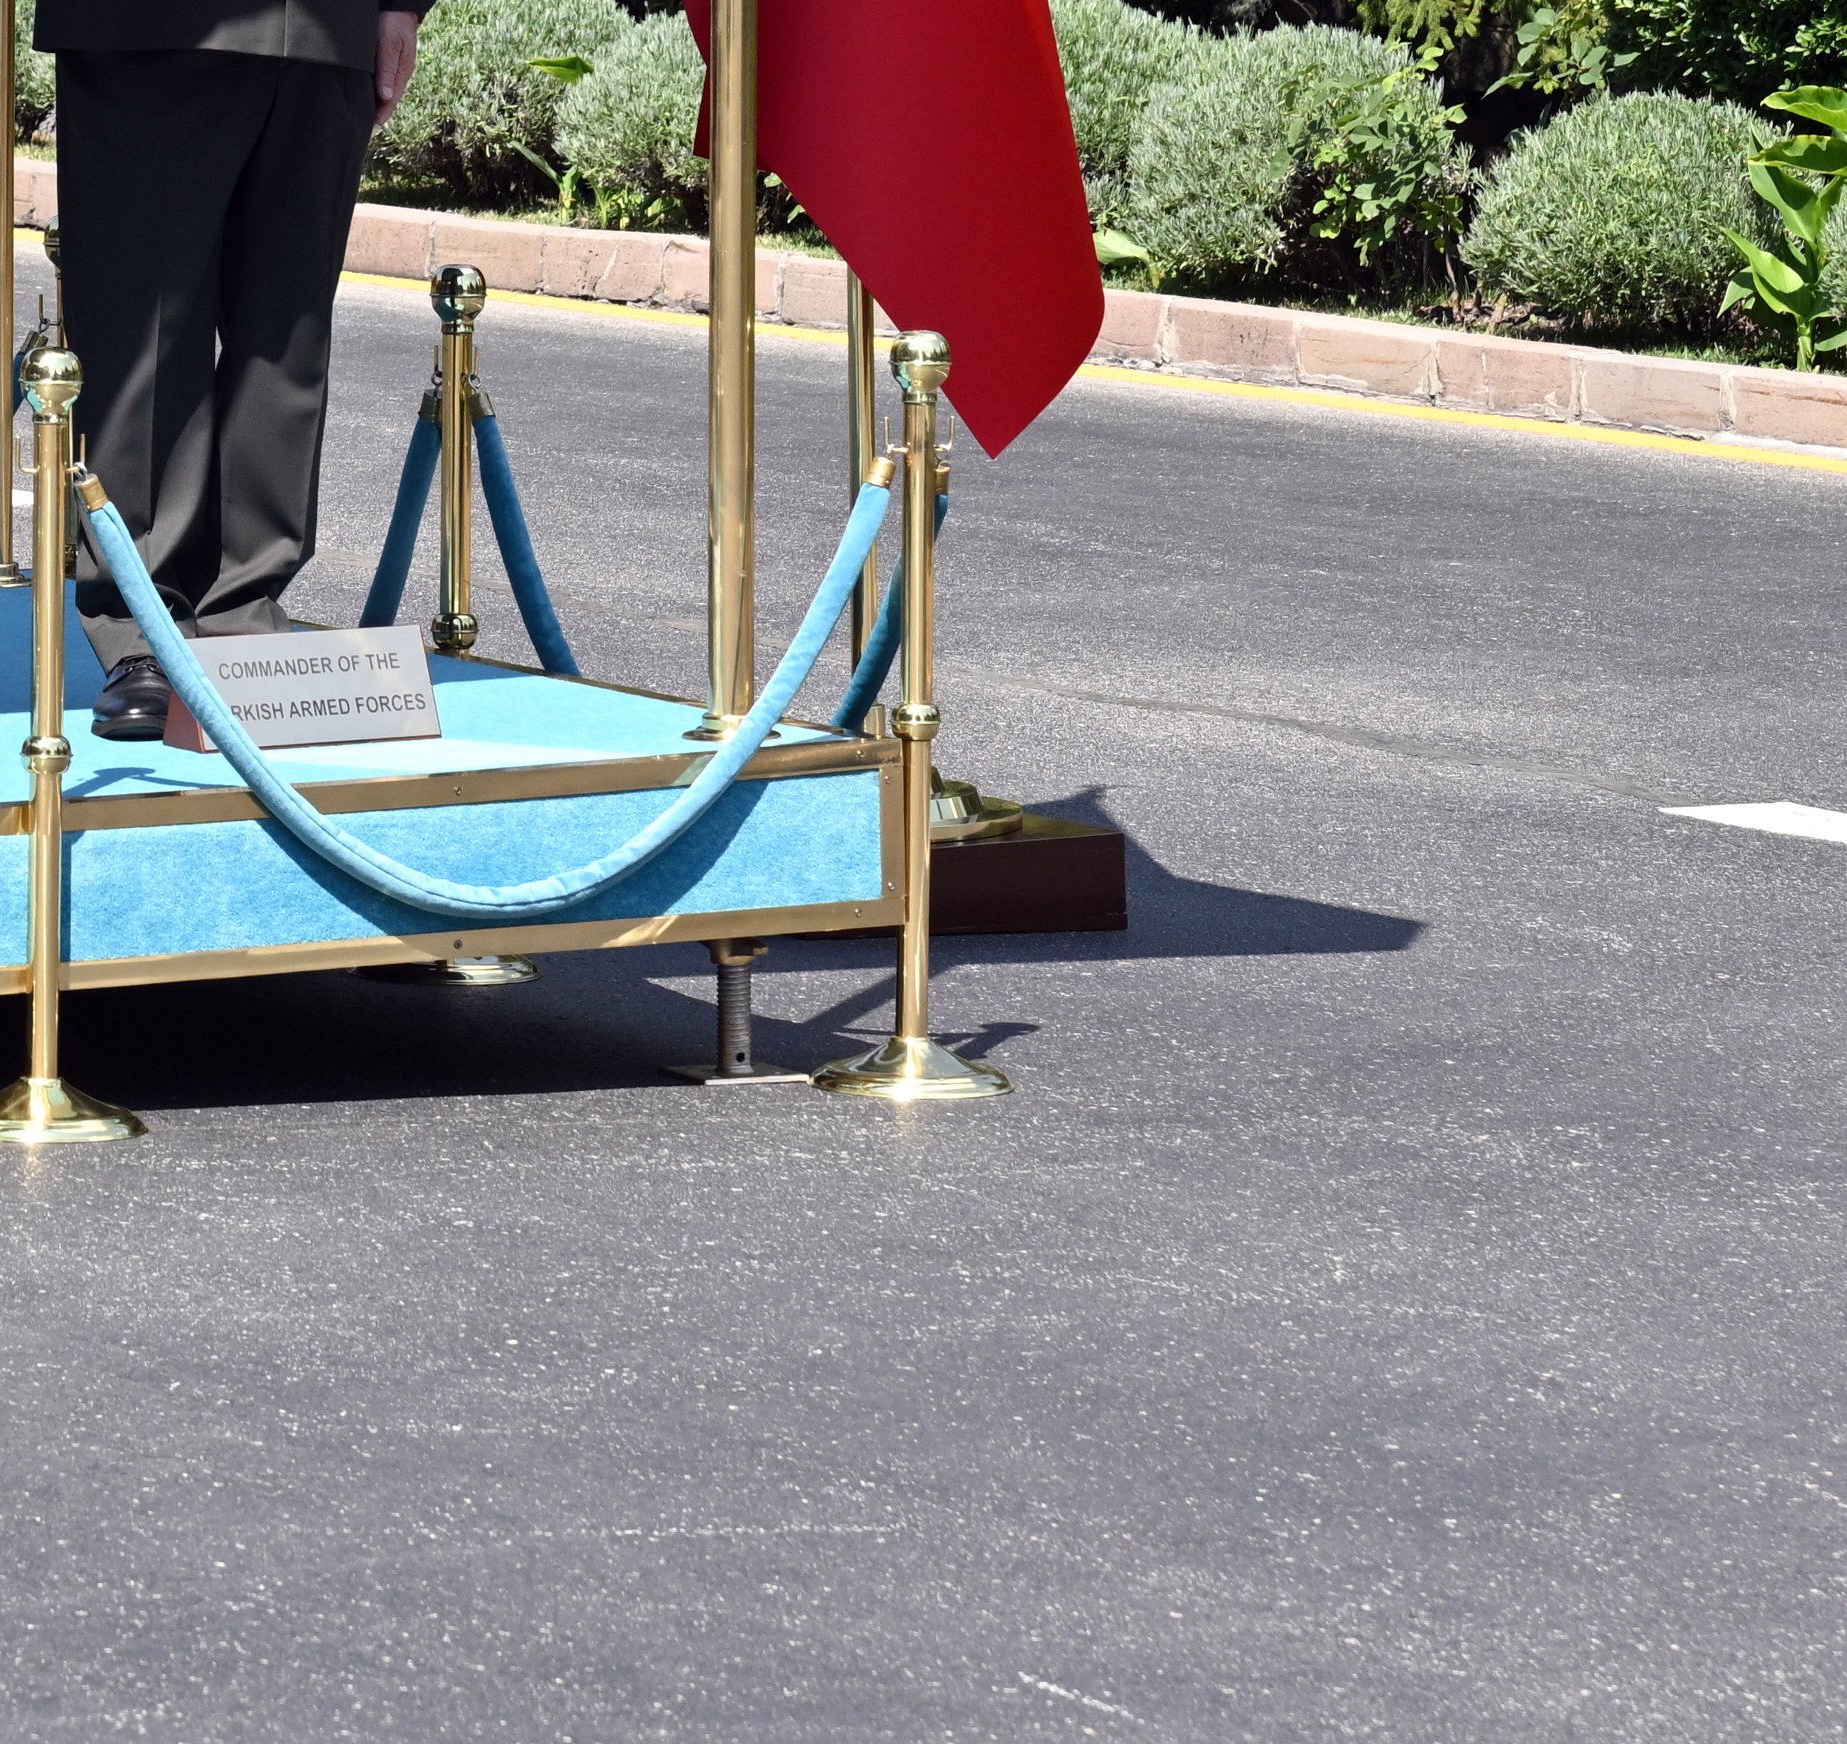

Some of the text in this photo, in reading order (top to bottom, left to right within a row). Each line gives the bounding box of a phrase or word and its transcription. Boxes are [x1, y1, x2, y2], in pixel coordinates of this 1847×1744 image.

[218, 652, 400, 680] COMMANDER OF THE
[231, 693, 426, 721] RKISH ARMED FORCES
